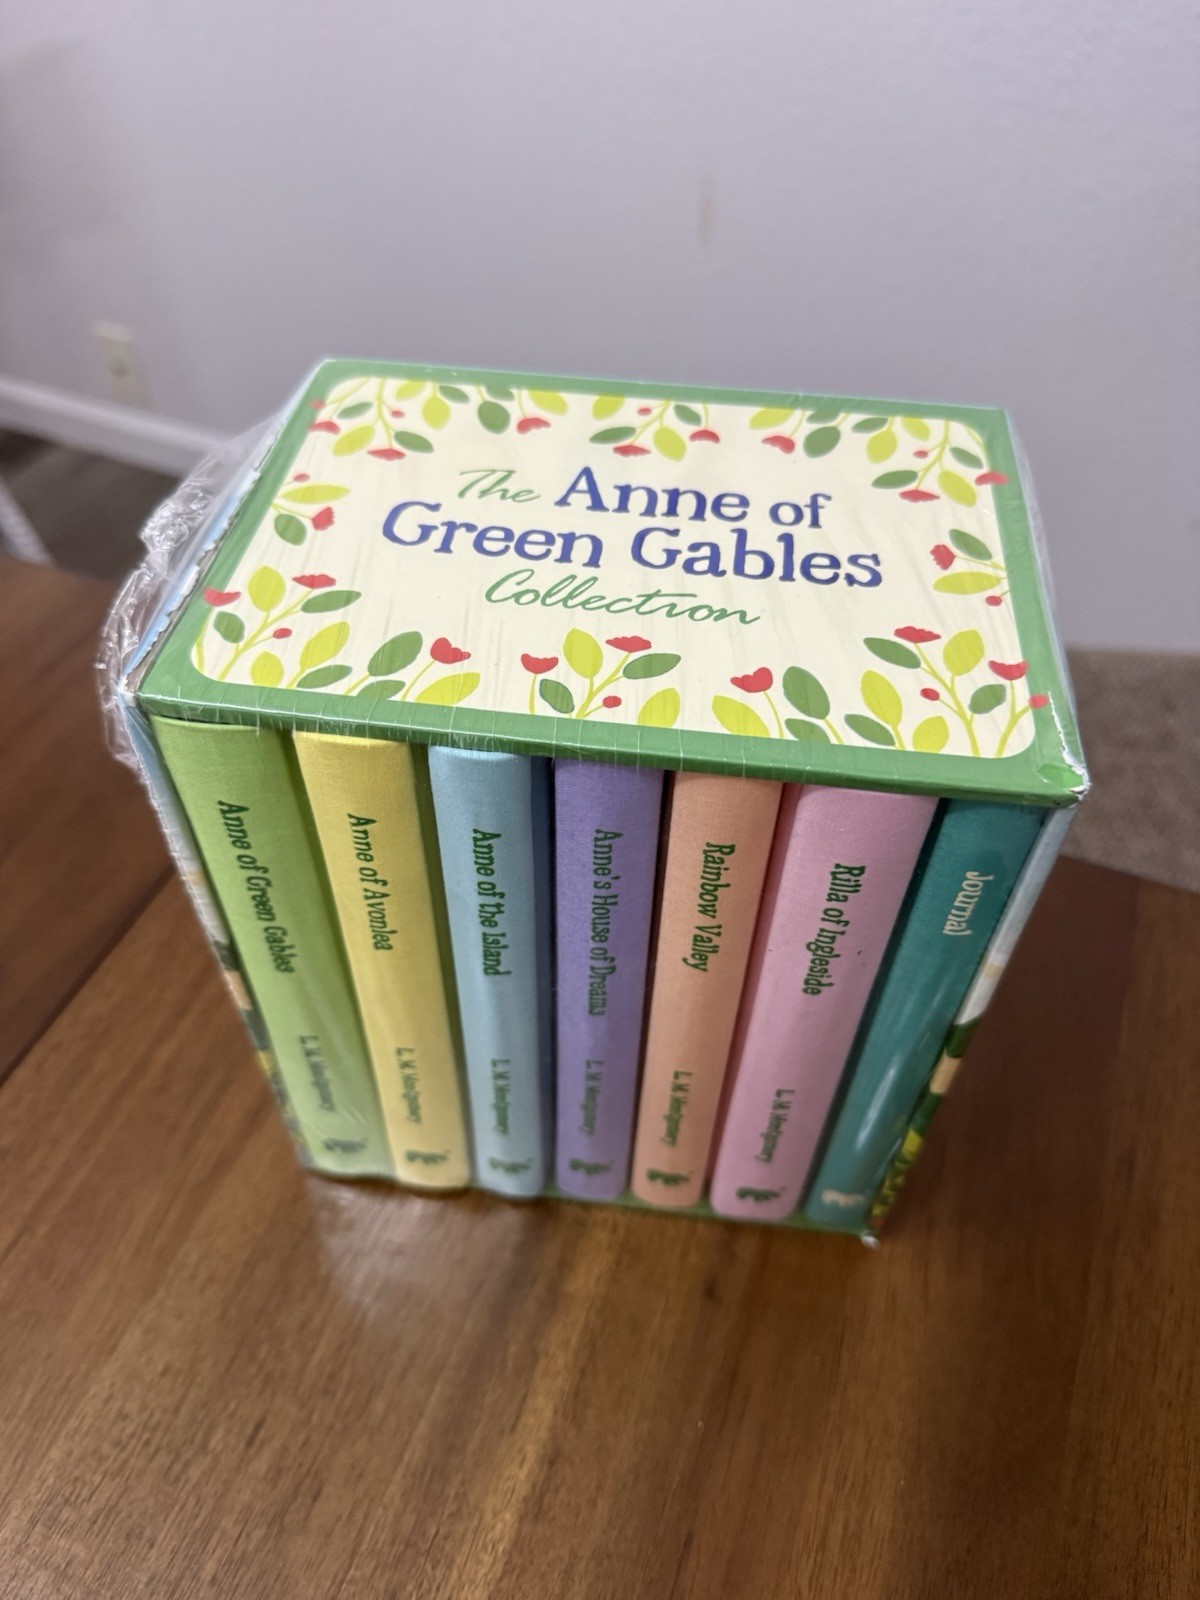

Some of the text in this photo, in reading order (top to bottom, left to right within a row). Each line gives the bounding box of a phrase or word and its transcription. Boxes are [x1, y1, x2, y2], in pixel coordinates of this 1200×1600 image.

[381, 501, 884, 588] Green Gables
[457, 466, 832, 529] The Anne of
[484, 567, 762, 625] Collection
[217, 800, 298, 973] Anne of Green Gables
[347, 813, 399, 951] Anne of Avonlea
[472, 828, 513, 976] Anne of the Island
[588, 828, 624, 1017] Anne's House of Dreams
[681, 841, 736, 973] Rainbow Valley
[802, 863, 867, 996] Rilla of Ingleside
[943, 871, 994, 935] Journal
